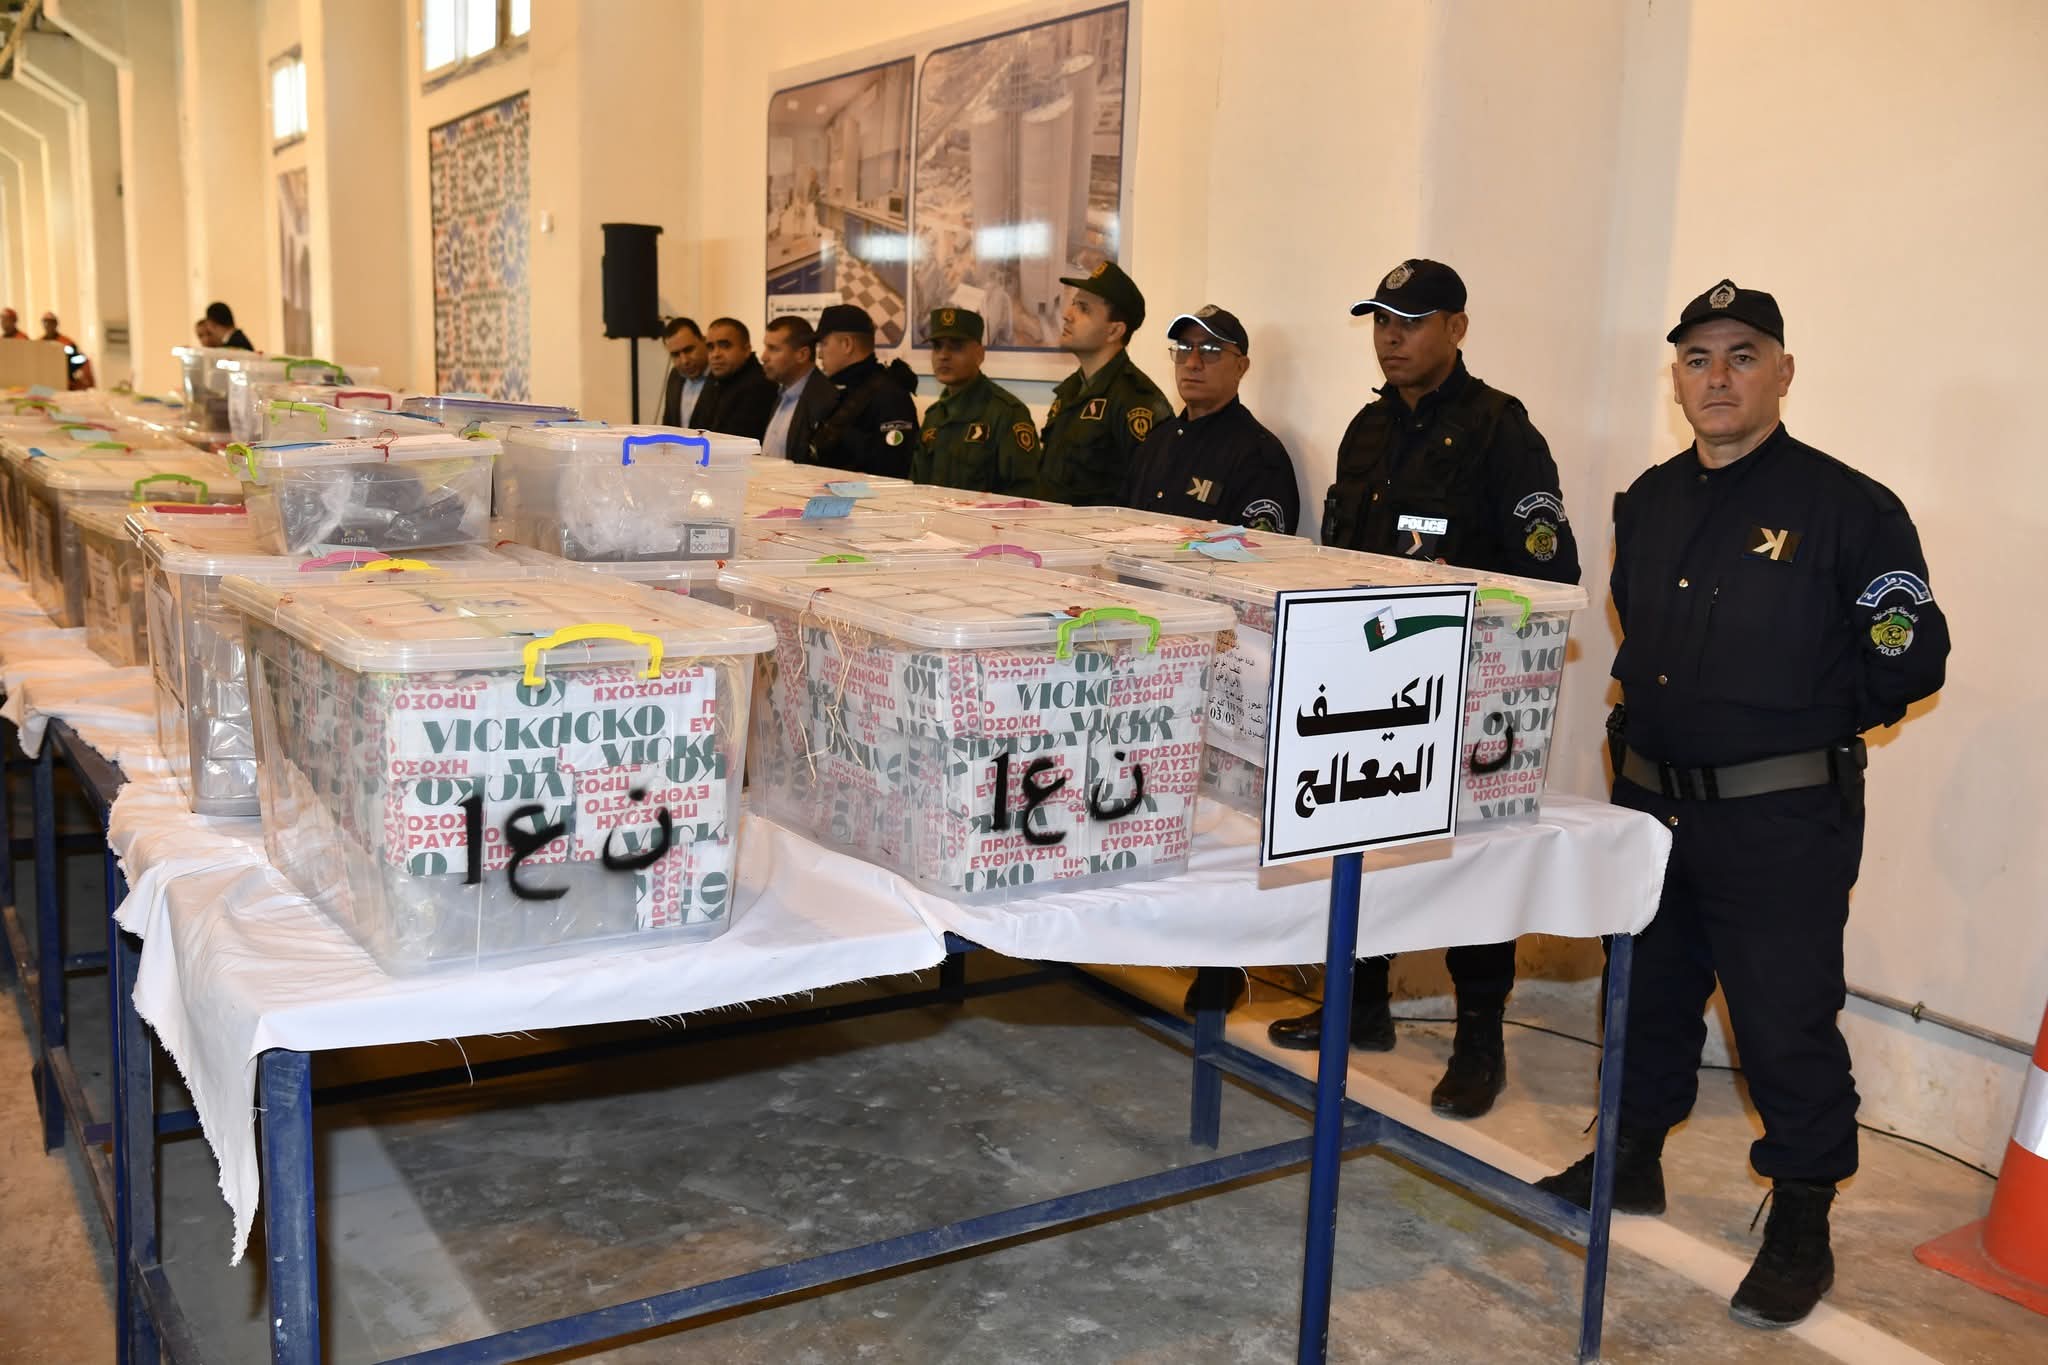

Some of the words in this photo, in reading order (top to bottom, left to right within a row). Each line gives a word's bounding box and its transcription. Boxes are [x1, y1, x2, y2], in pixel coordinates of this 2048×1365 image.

[1399, 517, 1446, 533] POLICE
[1296, 673, 1444, 741] الكيف
[1295, 742, 1435, 818] المعالج
